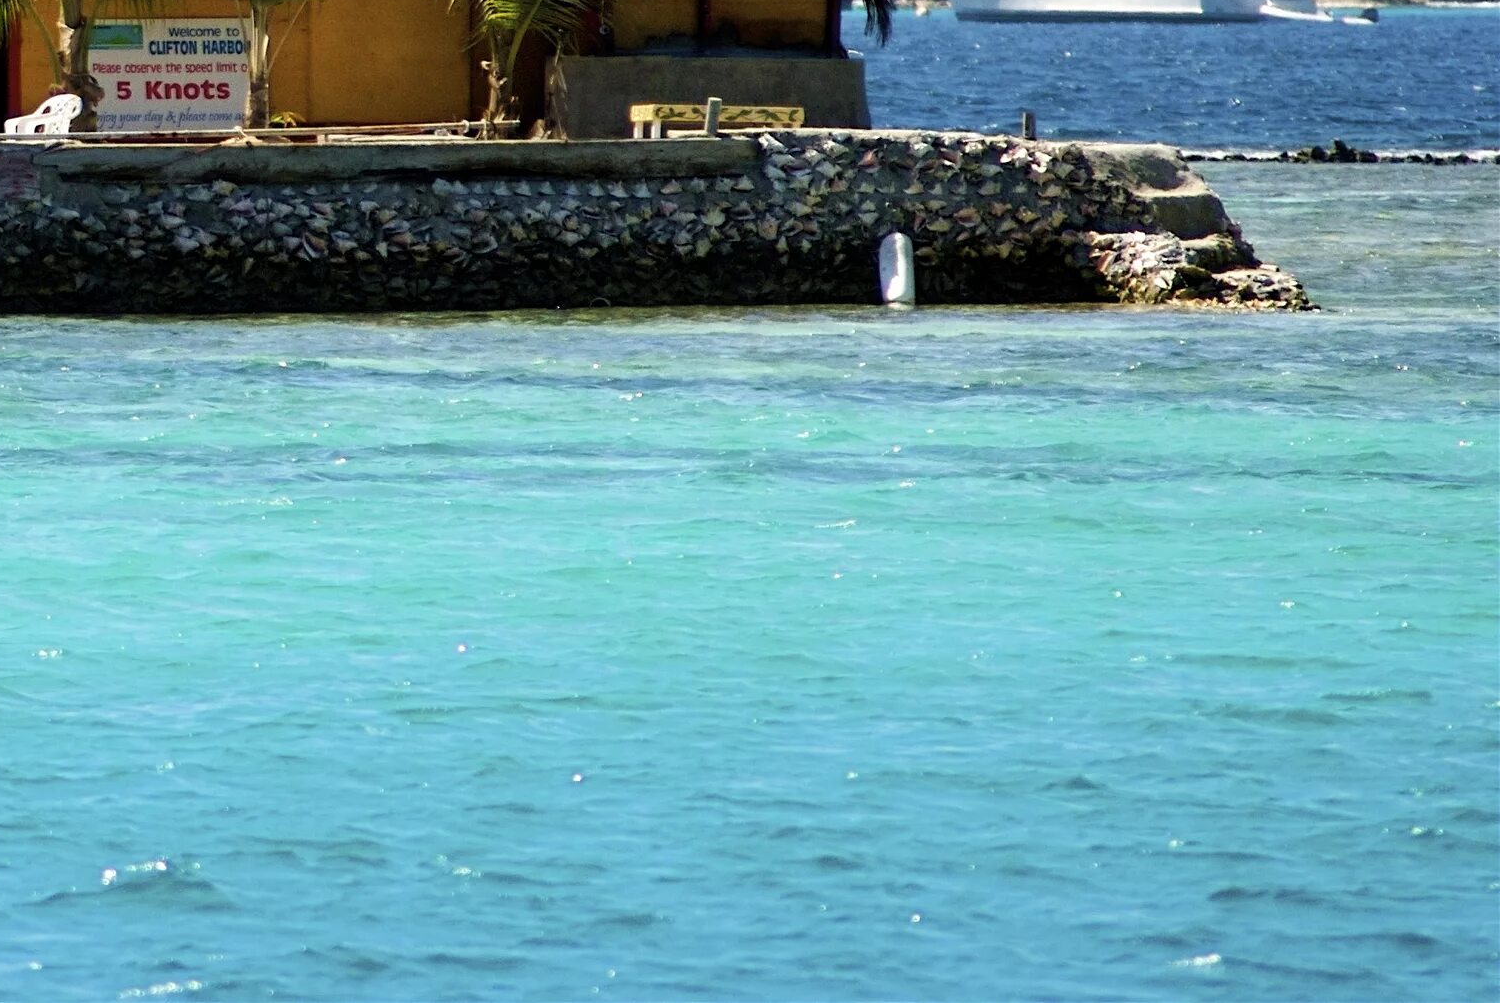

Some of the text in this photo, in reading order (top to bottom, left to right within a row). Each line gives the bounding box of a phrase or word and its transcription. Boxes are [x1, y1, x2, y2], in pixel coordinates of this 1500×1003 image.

[168, 27, 240, 37] Welcome to
[149, 40, 197, 55] CLIFTON
[92, 61, 248, 74] Please observe the speed limit o
[116, 79, 231, 100] 5 Knots
[97, 112, 116, 129] njoy
[117, 113, 142, 129] your
[166, 110, 177, 123] &
[176, 106, 206, 128] please
